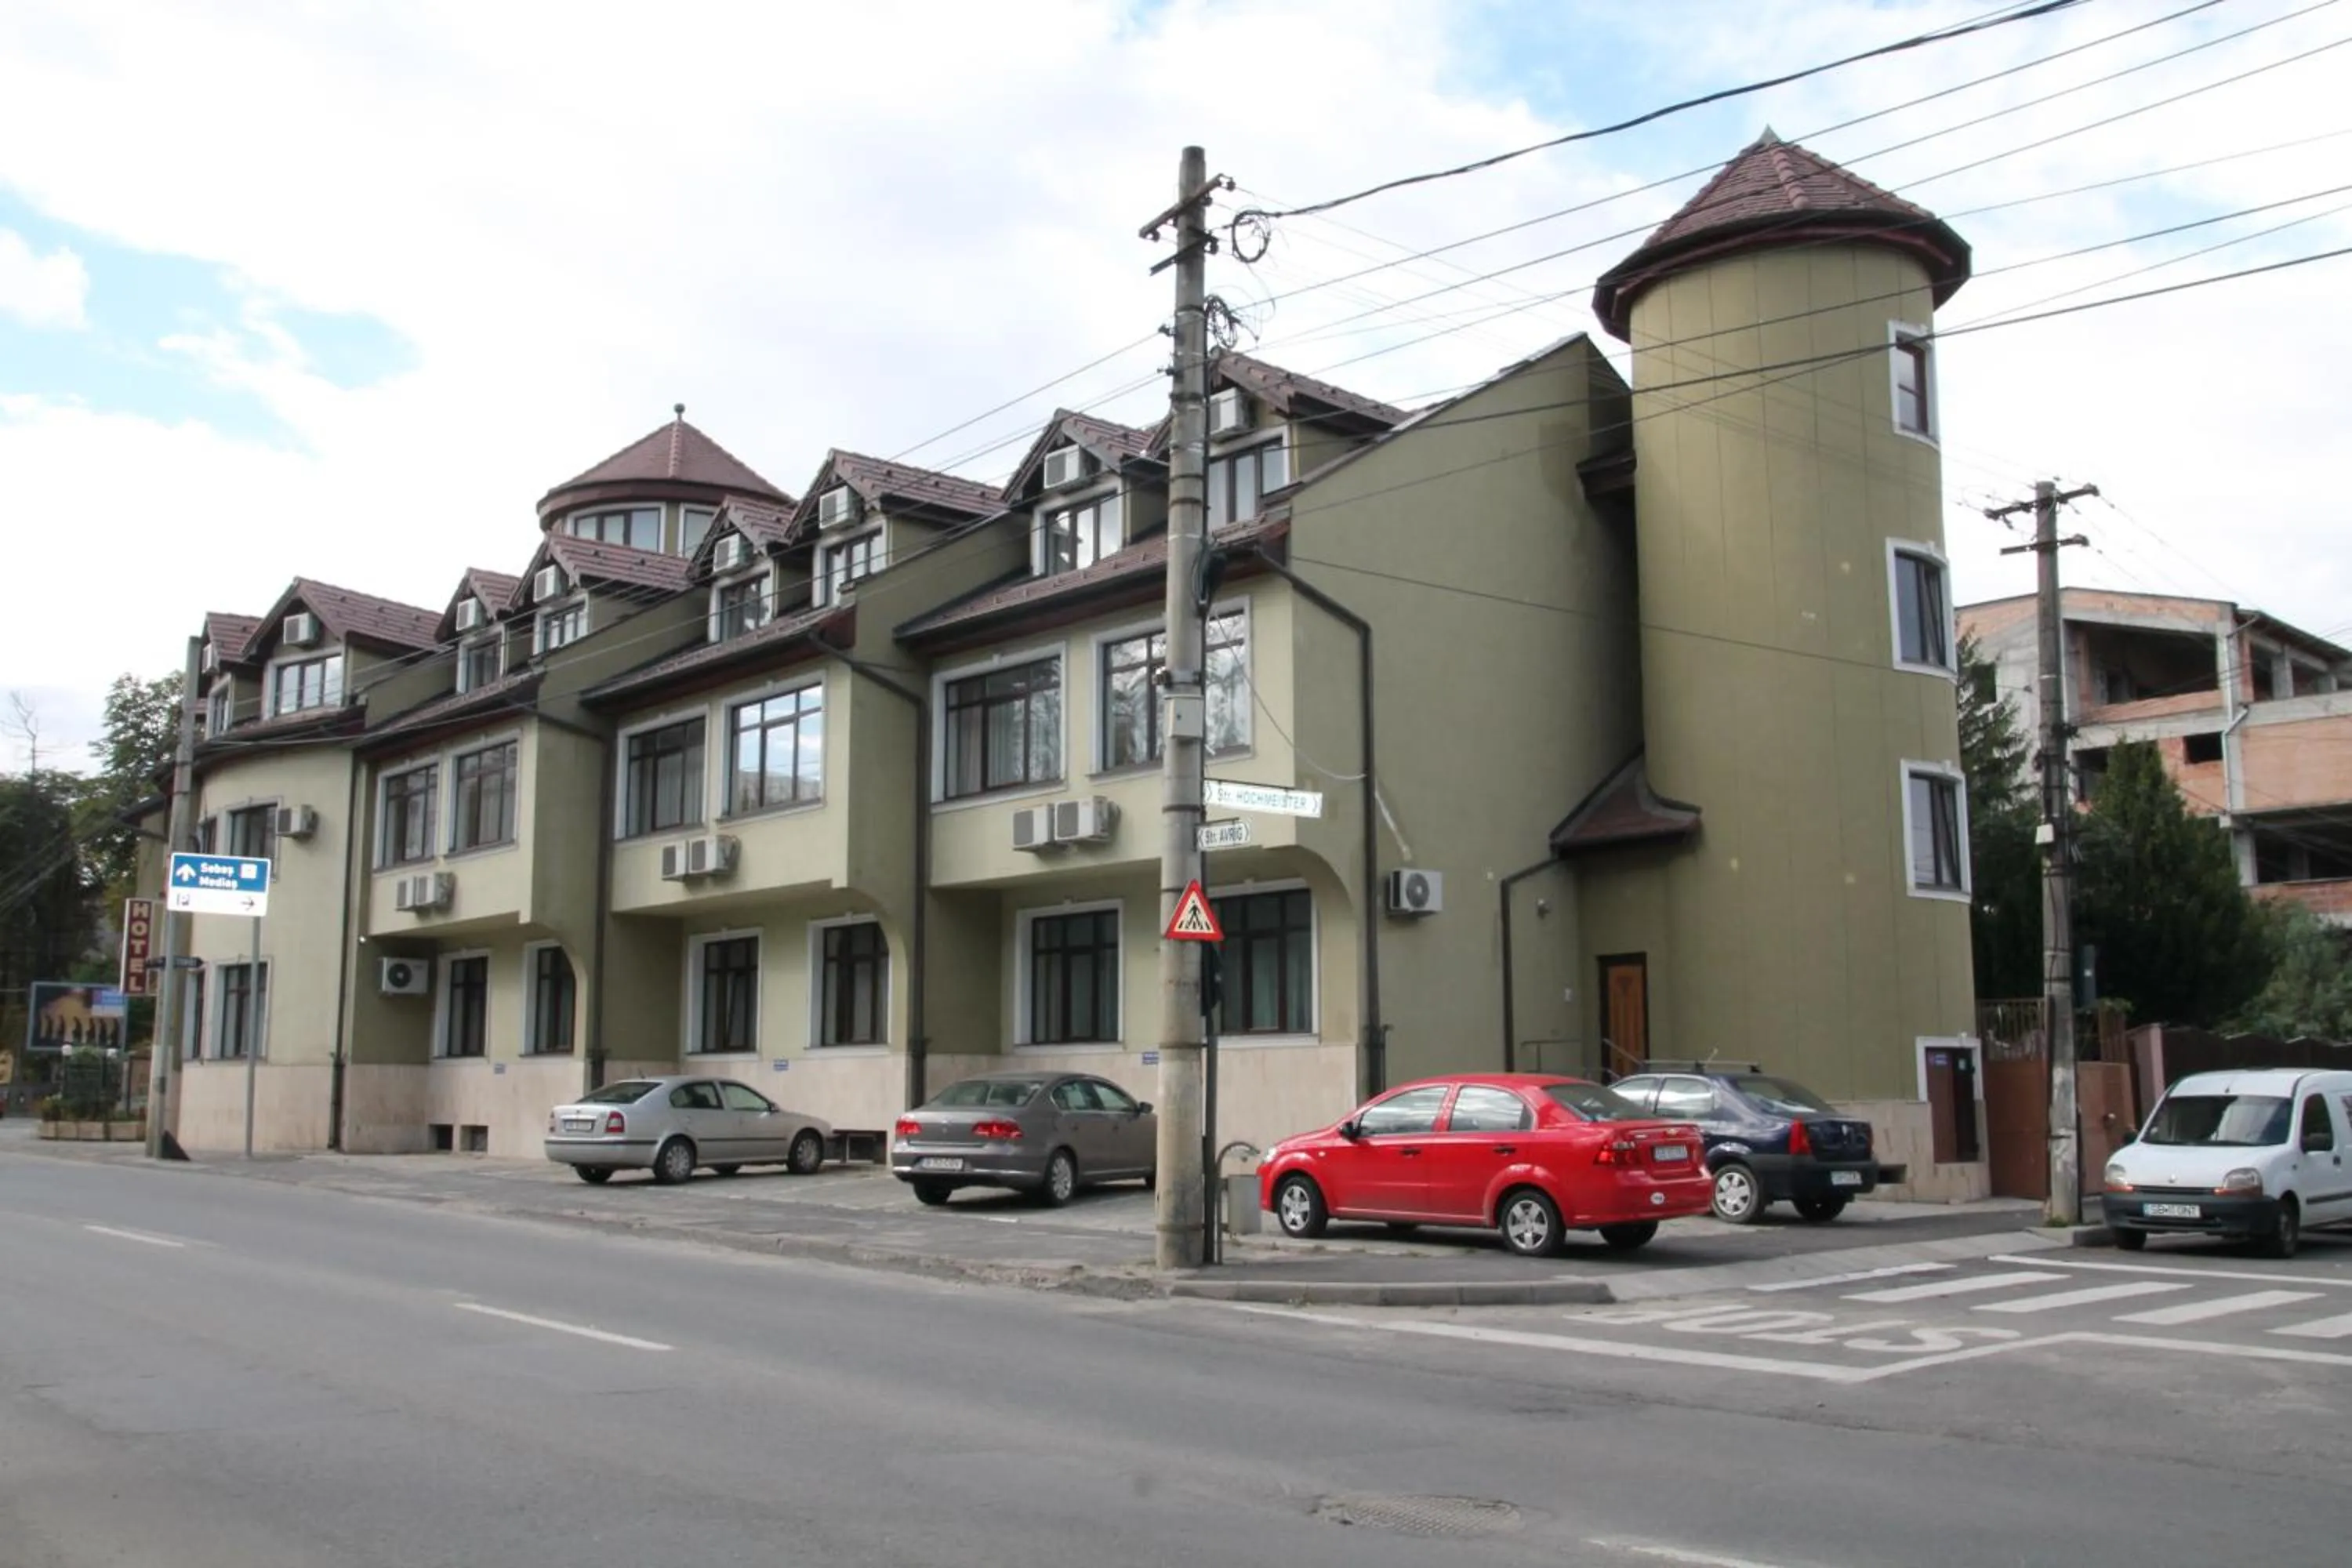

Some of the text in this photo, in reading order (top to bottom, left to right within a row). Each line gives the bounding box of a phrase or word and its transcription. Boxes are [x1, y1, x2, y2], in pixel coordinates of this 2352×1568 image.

[1236, 789, 1307, 810] HOCHMEISTER
[129, 902, 149, 992] HOTEL
[1562, 1305, 2020, 1352] STOP
